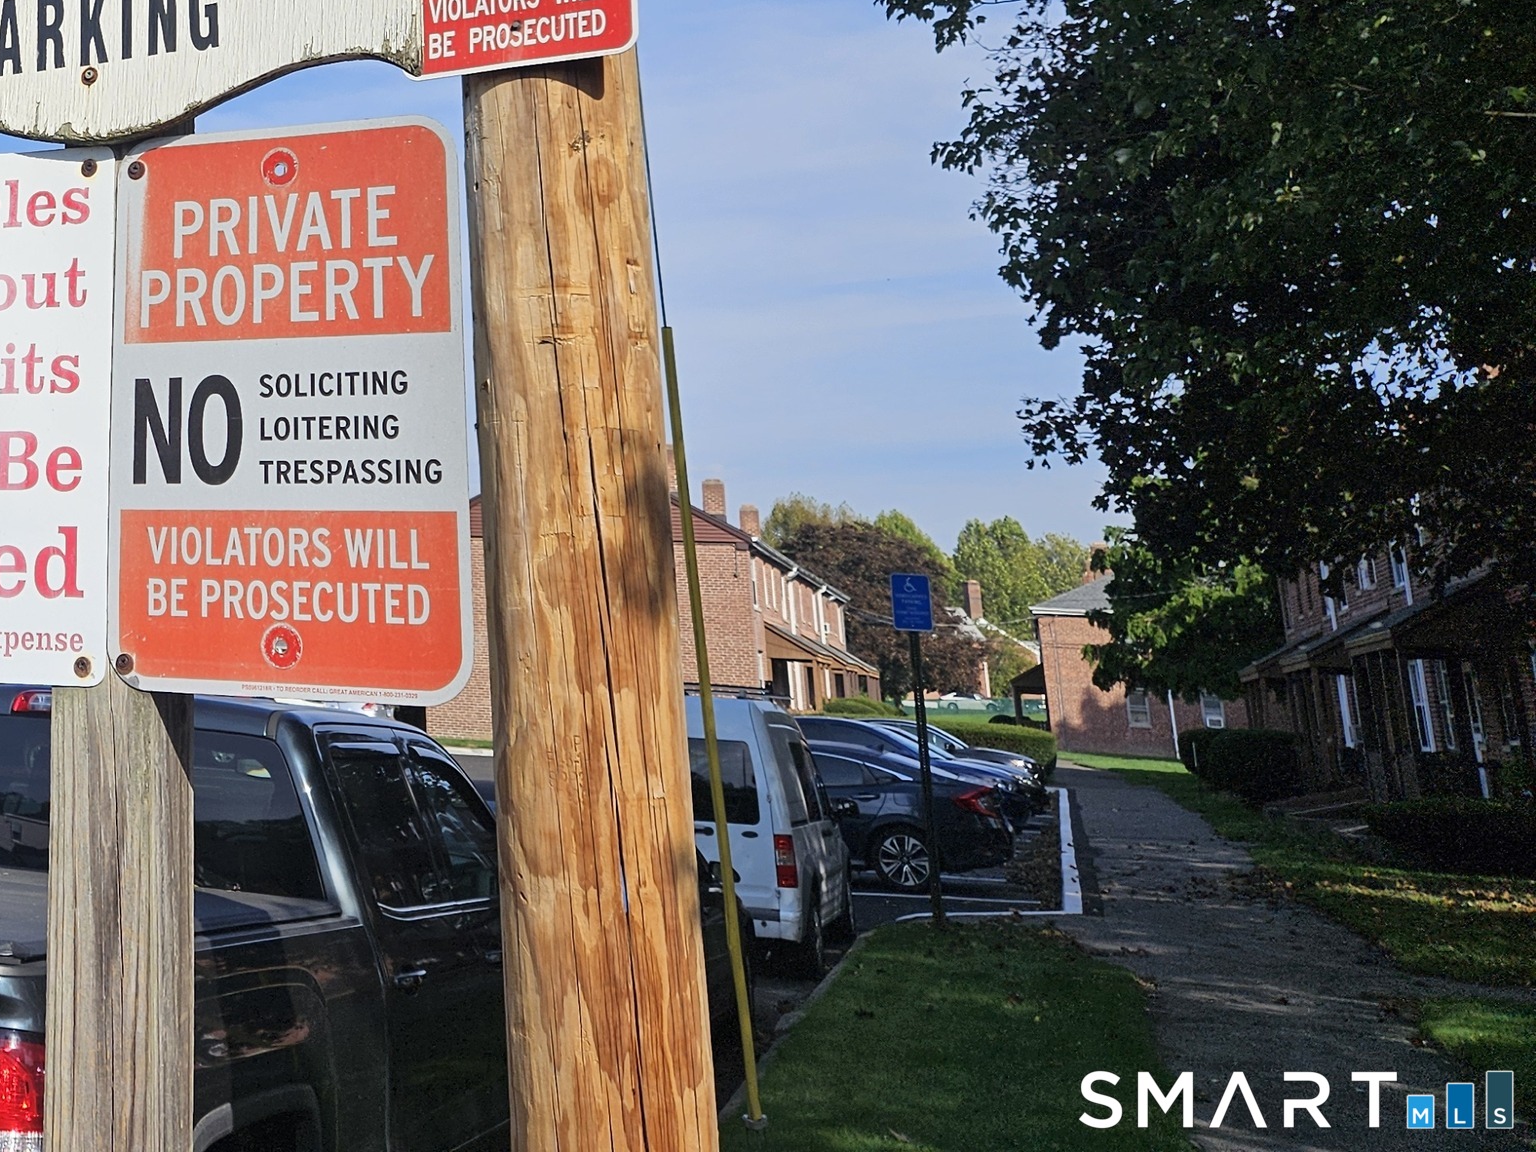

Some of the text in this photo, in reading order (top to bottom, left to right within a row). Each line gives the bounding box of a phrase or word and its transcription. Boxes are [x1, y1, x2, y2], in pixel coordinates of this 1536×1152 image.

[428, 8, 606, 60] BE PROSECUTED
[173, 185, 398, 259] PRIVATE
[140, 254, 435, 329] PROPERTY
[259, 370, 408, 398] SOLICITING
[132, 374, 243, 486] NO
[259, 414, 400, 441] LOITERING
[259, 458, 443, 486] TRESPASSING
[147, 526, 430, 570] VIOLATORS WILL
[147, 578, 431, 626] BE PROSECUTED
